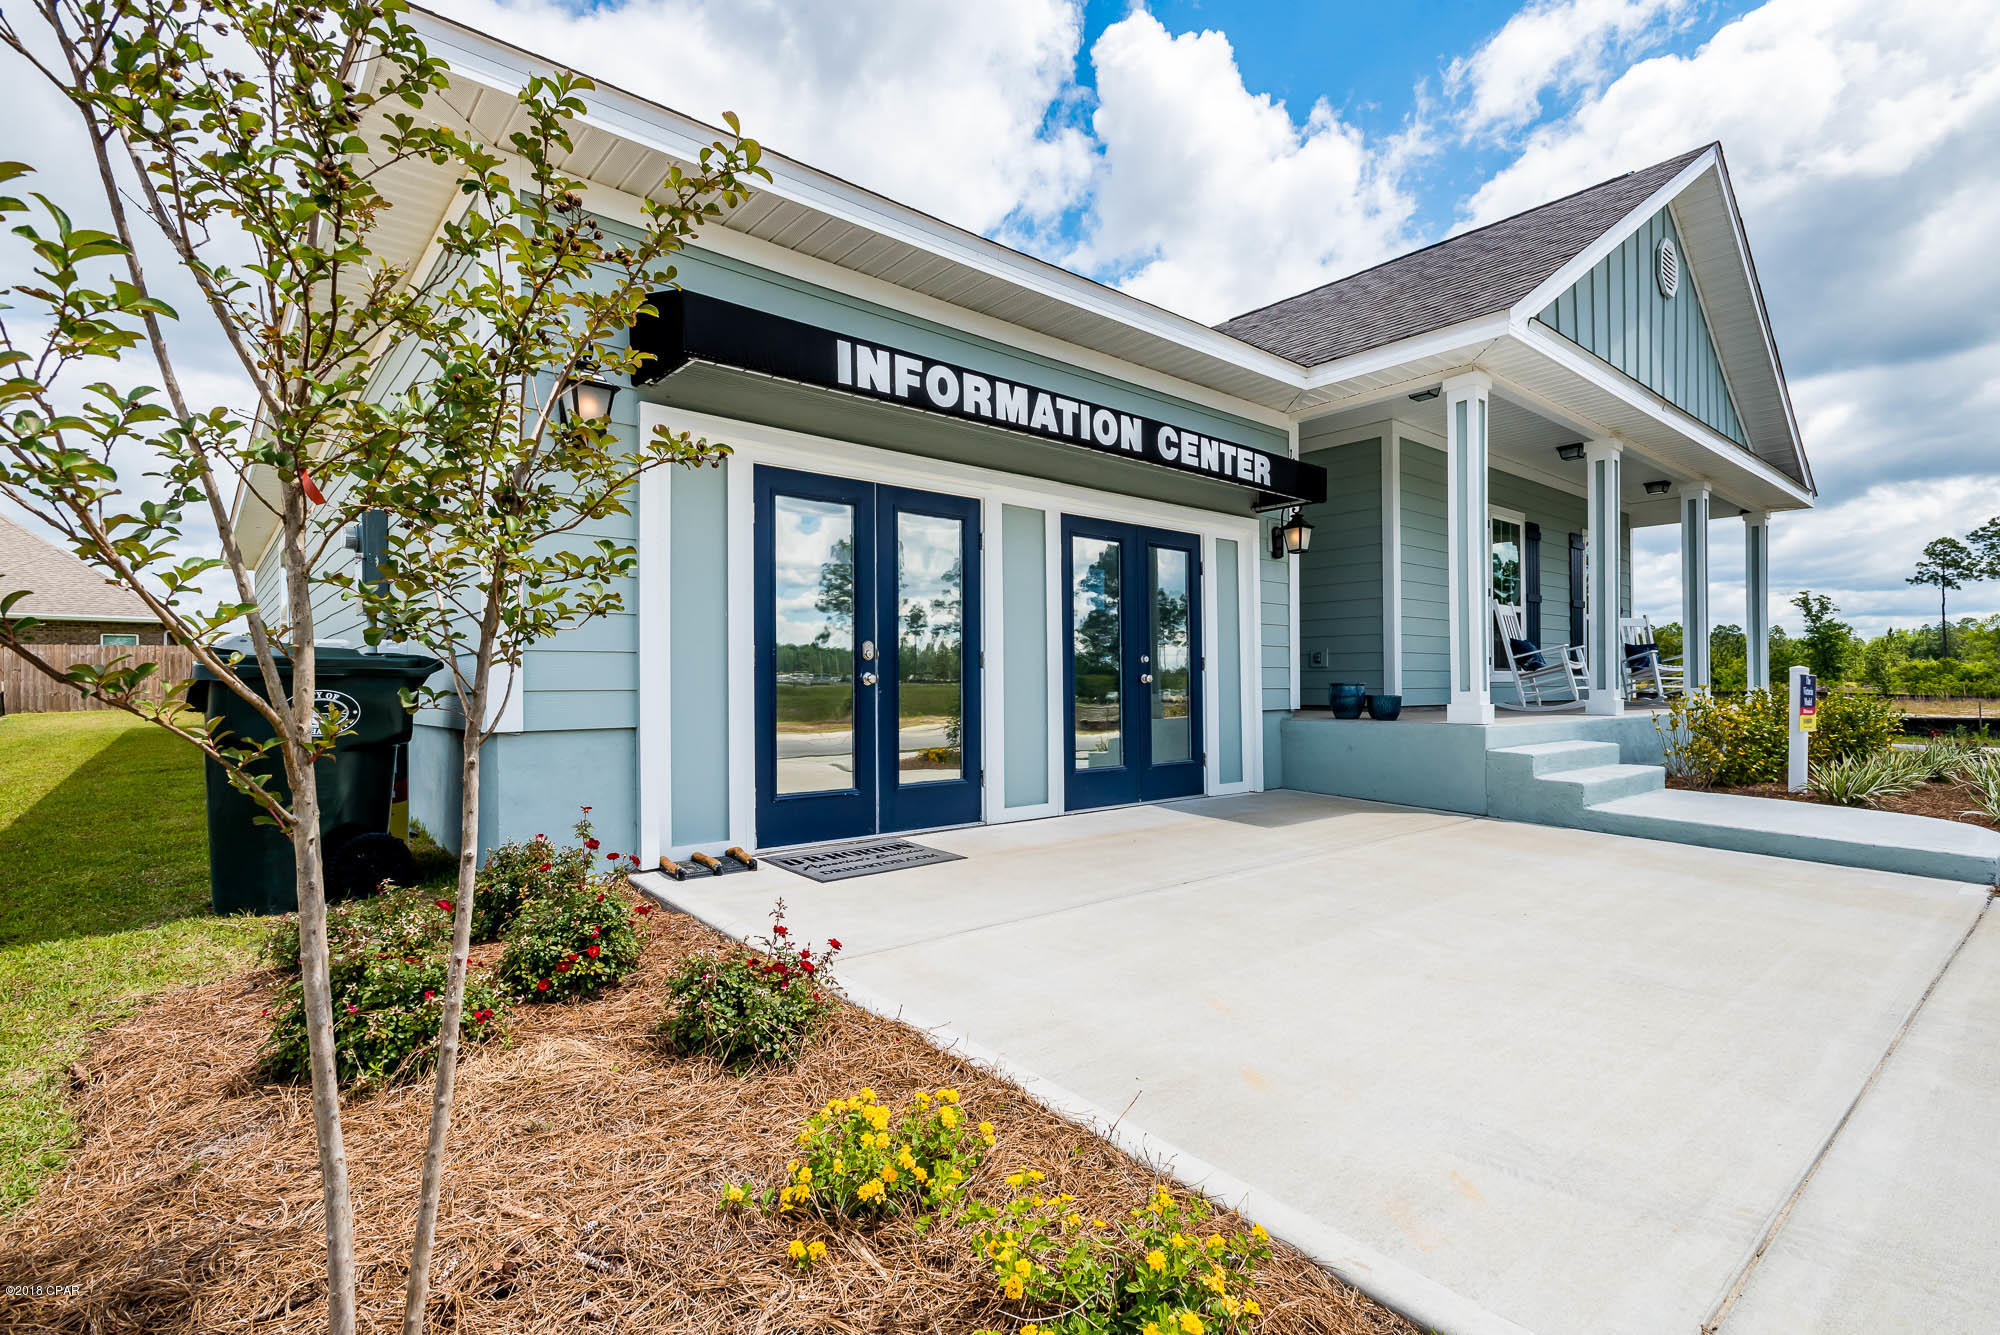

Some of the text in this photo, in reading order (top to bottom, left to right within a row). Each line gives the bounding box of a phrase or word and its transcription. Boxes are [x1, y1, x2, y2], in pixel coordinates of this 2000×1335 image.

[836, 340, 1271, 487] INFORMATION CENTER
[325, 692, 340, 700] OF
[803, 848, 927, 871] America's Builder
[819, 853, 939, 875] DRHORTON.COM
